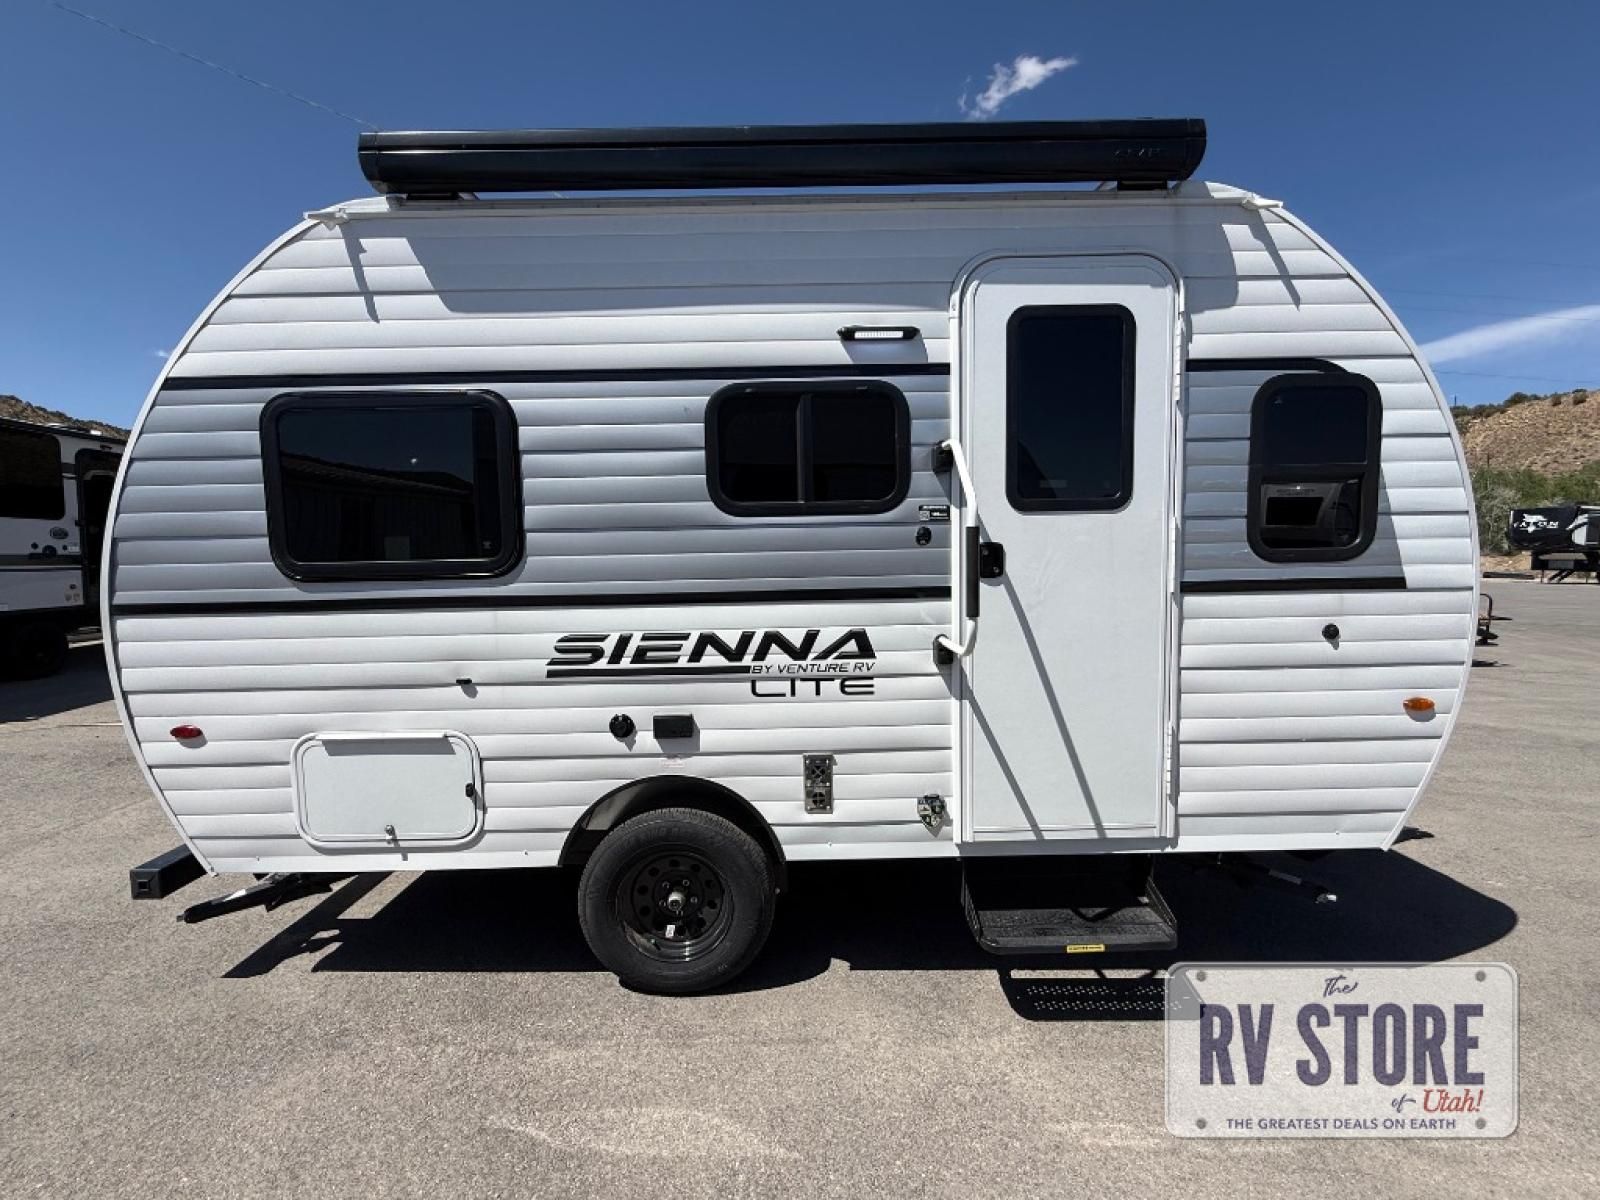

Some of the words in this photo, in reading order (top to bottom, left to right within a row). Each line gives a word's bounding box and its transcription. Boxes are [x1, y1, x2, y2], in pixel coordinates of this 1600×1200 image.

[546, 628, 877, 666] SIENNA
[751, 665, 773, 675] BY
[777, 663, 849, 674] VENTURE
[853, 661, 876, 672] RV
[750, 676, 875, 698] LITE
